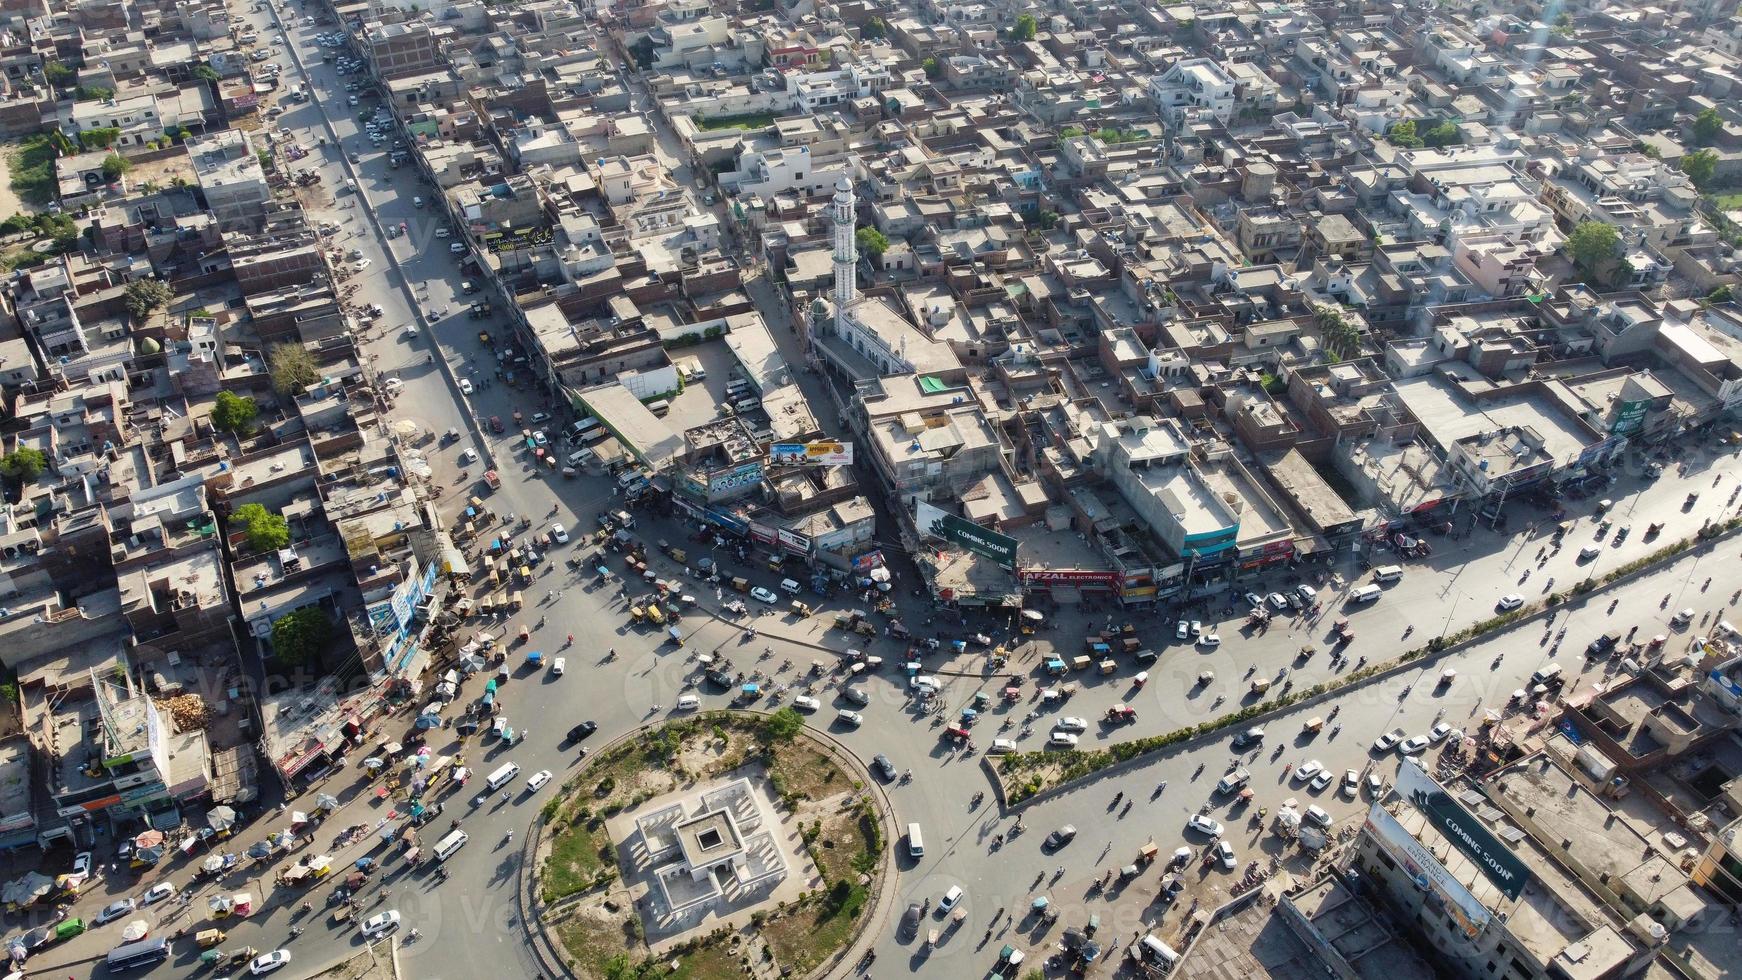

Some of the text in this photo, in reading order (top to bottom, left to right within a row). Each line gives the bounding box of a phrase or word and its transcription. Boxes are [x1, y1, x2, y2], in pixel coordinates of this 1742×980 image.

[957, 529, 985, 546] COMING
[986, 541, 1009, 555] SOON
[1416, 848, 1442, 875] GRAND
[1445, 817, 1481, 855] COMING
[1482, 850, 1514, 881] SOON
[1407, 846, 1448, 887] ENTRANCE
